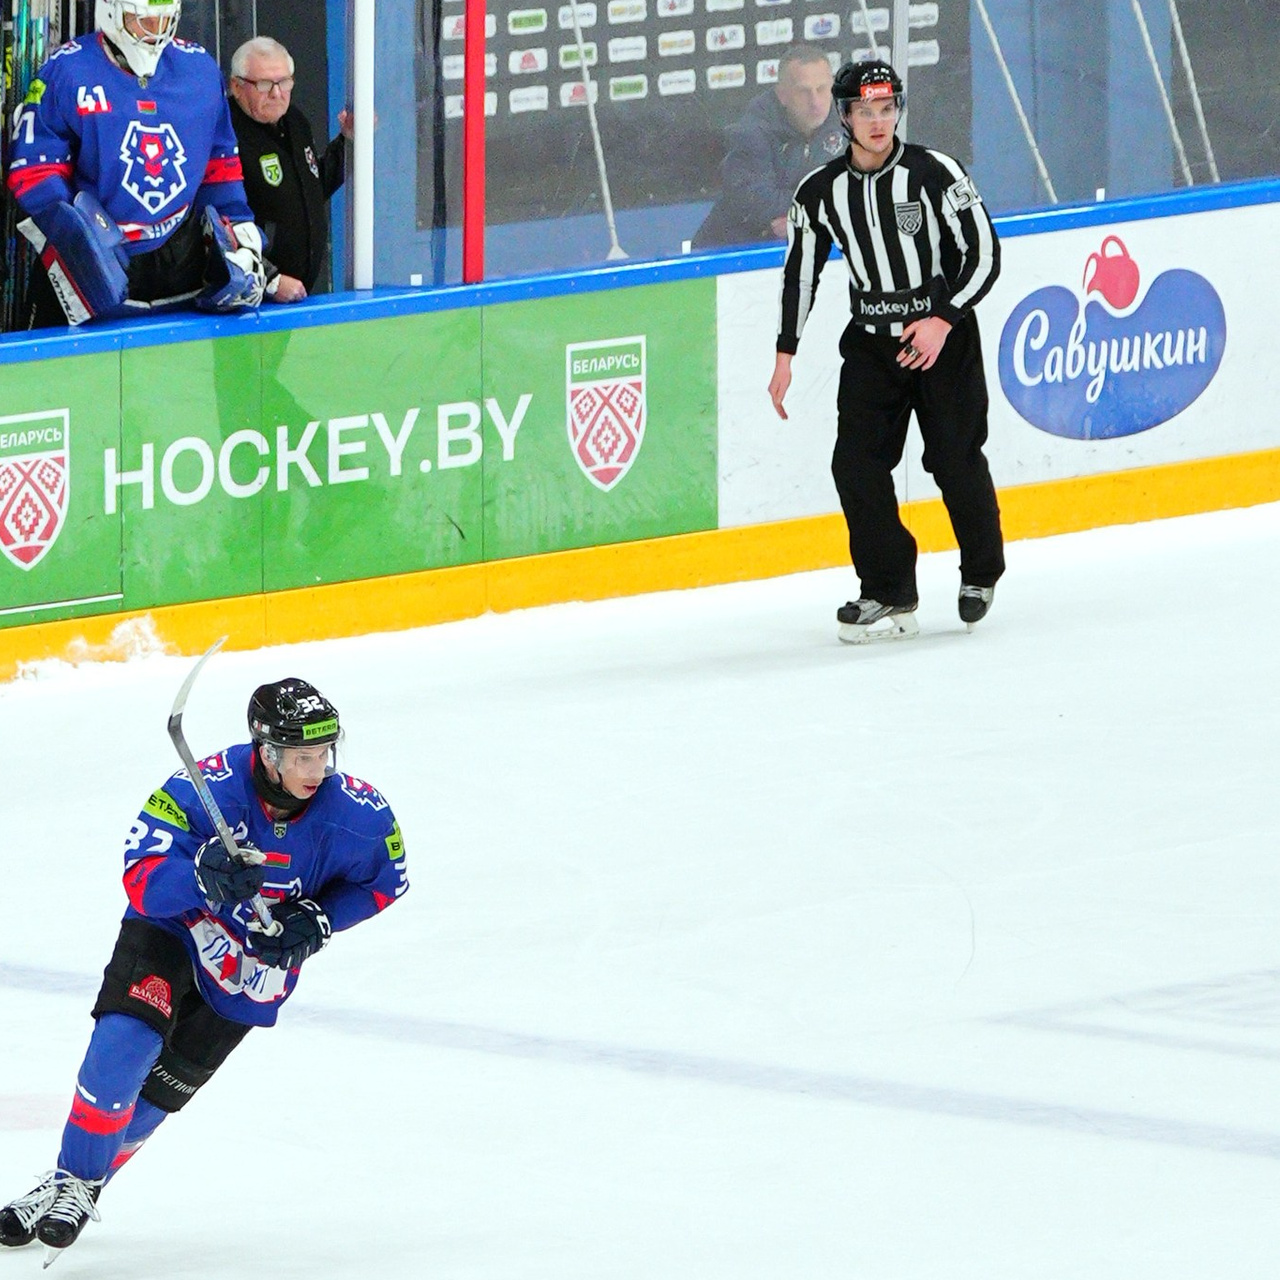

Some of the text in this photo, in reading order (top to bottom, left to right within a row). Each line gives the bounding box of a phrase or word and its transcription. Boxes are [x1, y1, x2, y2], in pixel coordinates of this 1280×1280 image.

[76, 85, 109, 112] 41
[860, 296, 932, 316] hockey.by
[572, 354, 640, 377] БЕЛАРУСЬ
[1013, 309, 1207, 402] Савушкин
[104, 393, 533, 515] HOCKEY.BY
[296, 694, 324, 713] 32
[306, 722, 337, 736] BETERA
